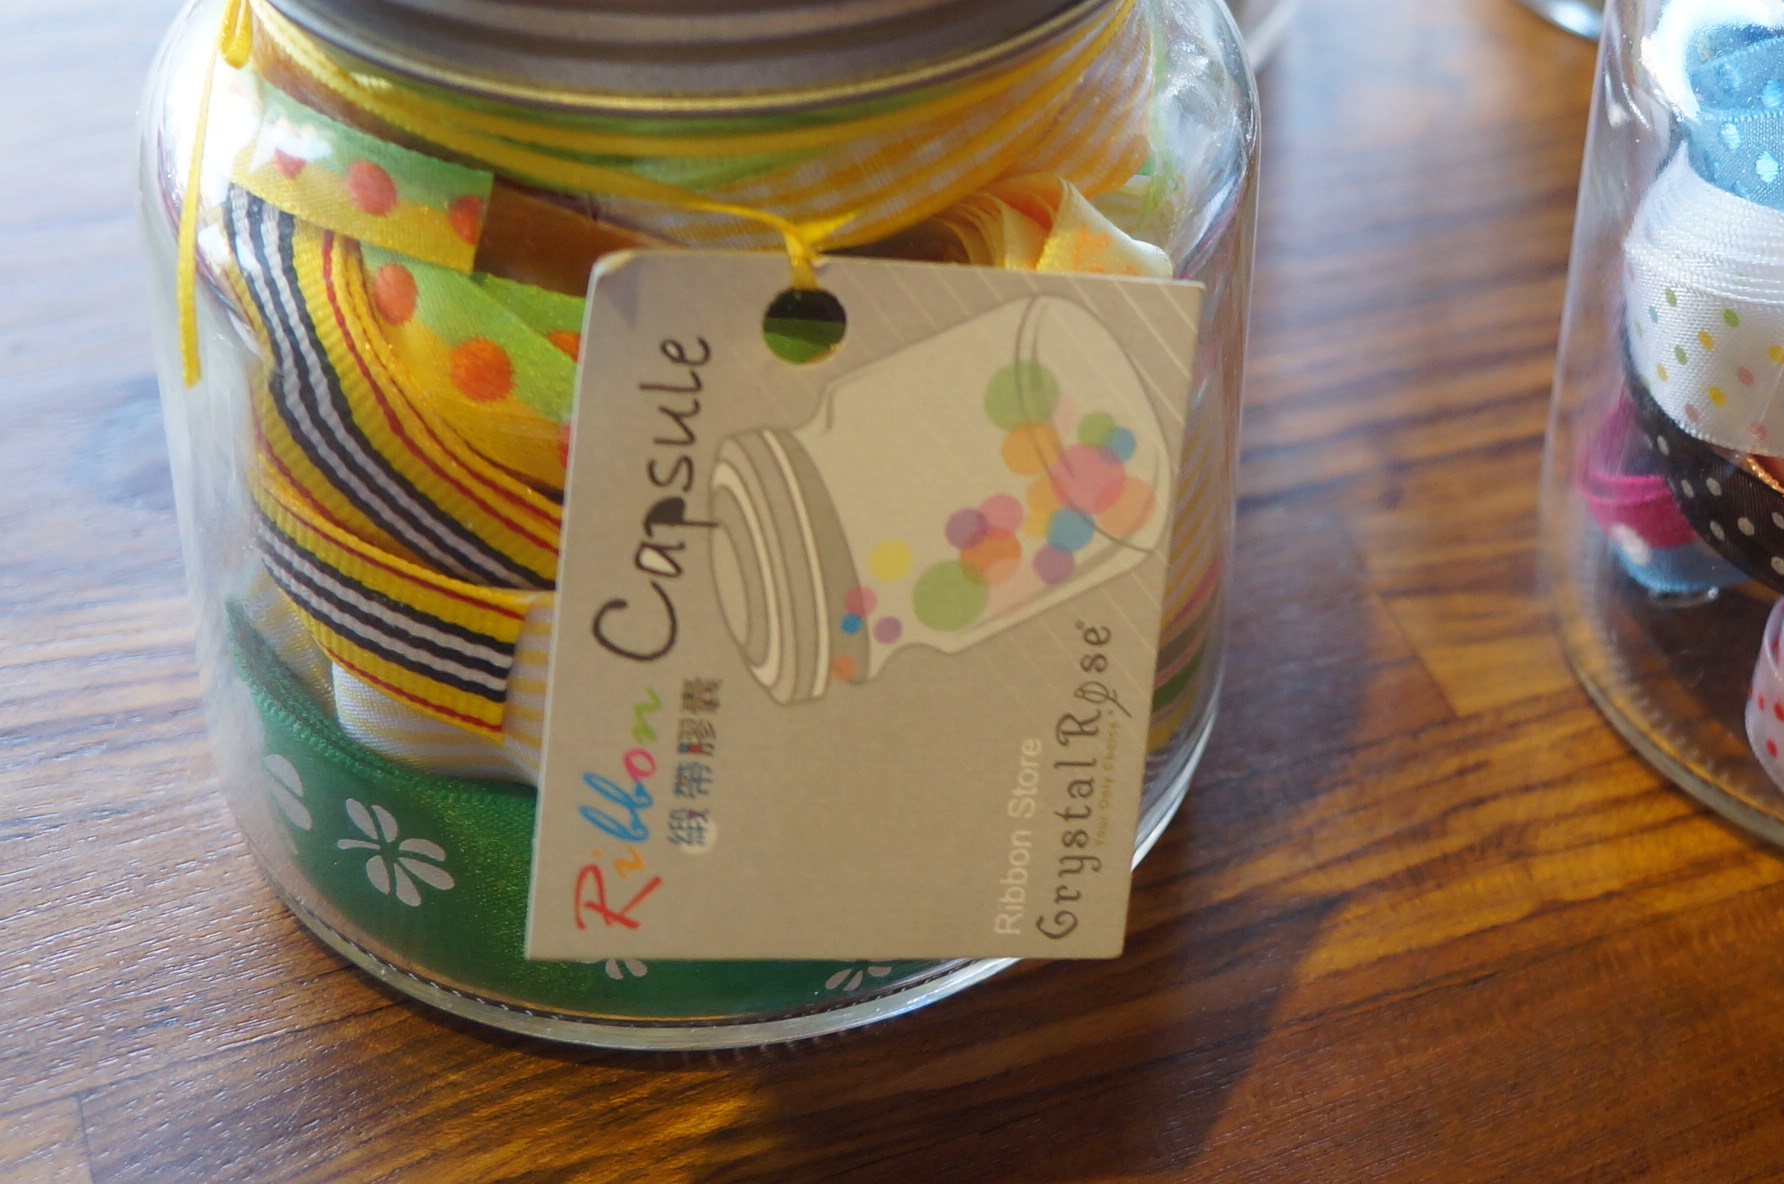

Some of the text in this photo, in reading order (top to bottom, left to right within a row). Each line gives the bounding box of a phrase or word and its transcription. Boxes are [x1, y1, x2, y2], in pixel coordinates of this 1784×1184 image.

[574, 335, 718, 931] Ribbon Capsule
[994, 736, 1043, 936] Ribbon Store
[1034, 757, 1102, 941] Crystal
